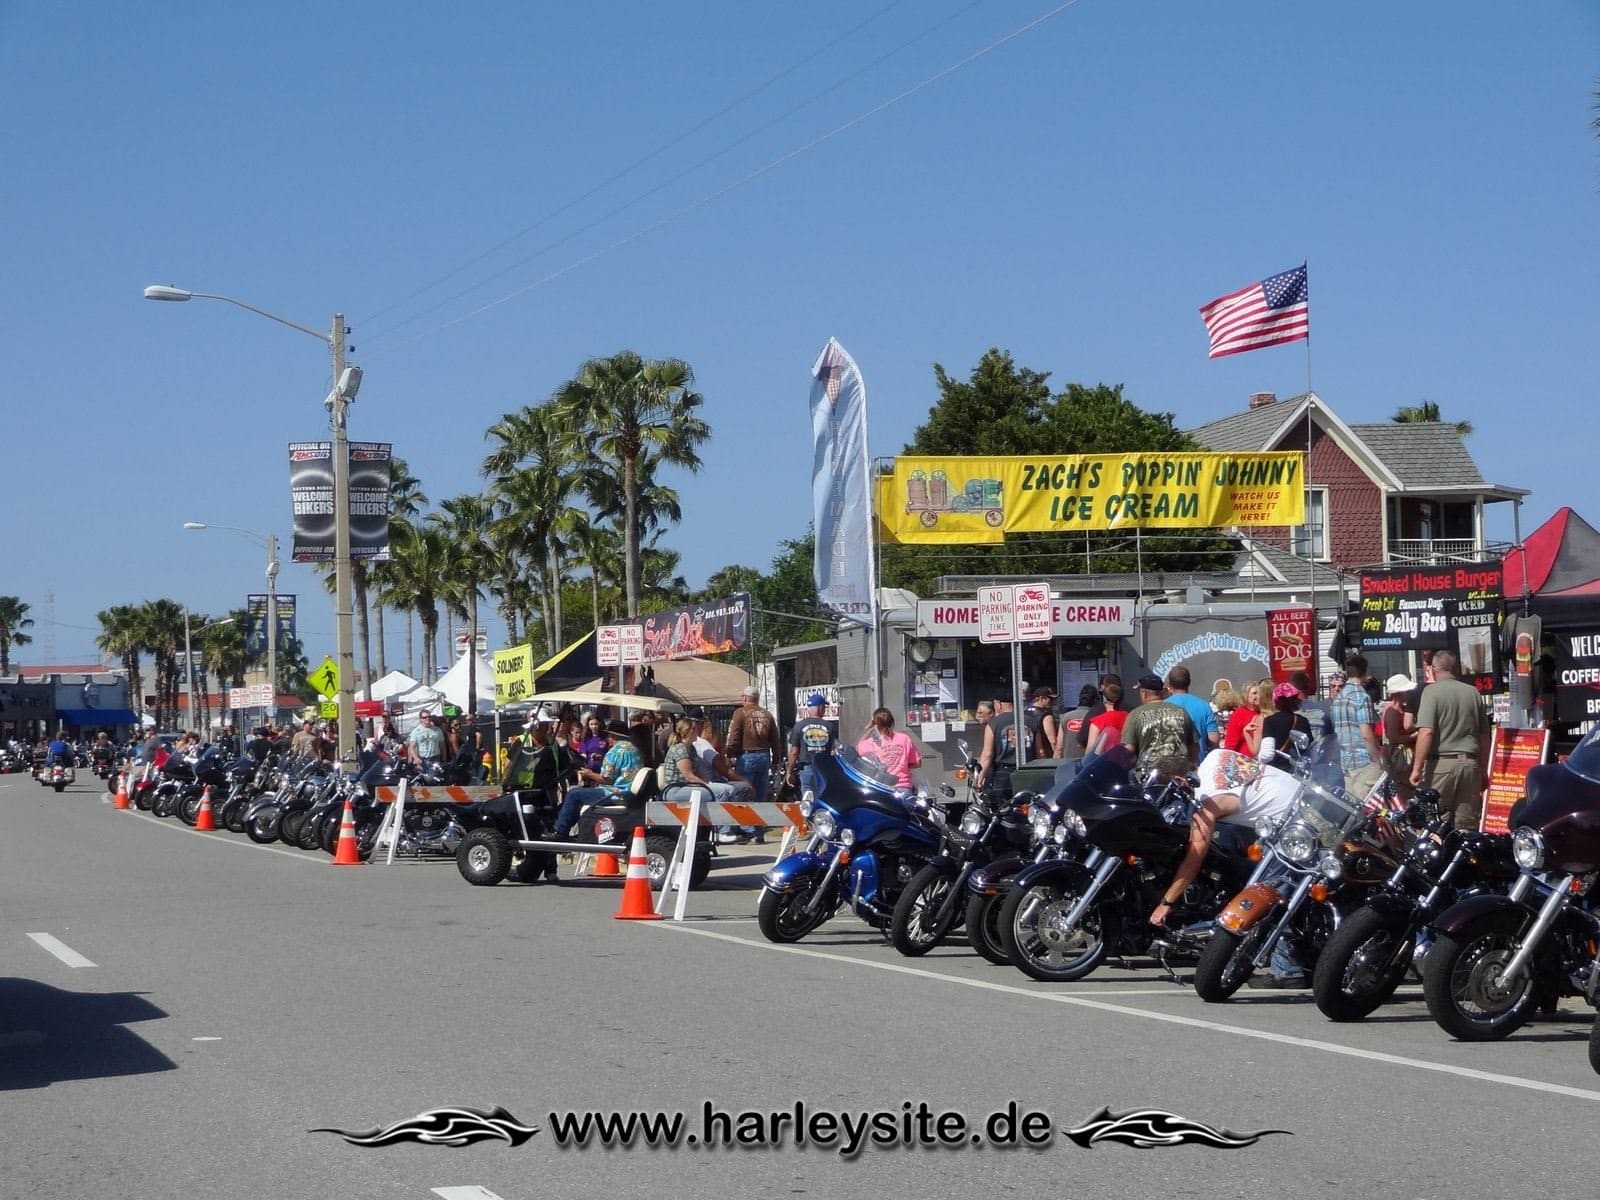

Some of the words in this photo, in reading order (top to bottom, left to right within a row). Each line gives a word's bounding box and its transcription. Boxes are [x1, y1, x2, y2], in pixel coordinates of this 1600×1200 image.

[290, 443, 318, 451] OFFICIAL
[319, 442, 331, 450] OIL
[350, 443, 375, 451] OFFICIAL
[1022, 461, 1103, 490] ZACH'S
[1215, 459, 1298, 486] JOHNNY
[292, 491, 334, 501] WELCOME
[350, 492, 388, 502] WELCOME
[1230, 492, 1264, 500] WATCH
[1266, 491, 1280, 499] US
[294, 502, 334, 515] BIKERS
[350, 503, 387, 515] BIKERS
[1050, 496, 1093, 521] ICE
[1105, 492, 1199, 520] CREAM
[1265, 502, 1276, 510] IT
[1239, 512, 1271, 521] HERE!
[1362, 574, 1409, 595] Smoked
[1413, 573, 1451, 592] House
[1455, 570, 1500, 591] Burger
[989, 591, 1003, 602] NO
[982, 603, 1011, 614] PARKING
[1016, 603, 1048, 612] PARKING
[1362, 598, 1382, 611] Fresh
[1383, 597, 1395, 610] Cut
[1399, 600, 1427, 609] Famous
[1458, 600, 1485, 611] ICED
[934, 607, 979, 624] HOME
[991, 615, 1004, 623] ANY
[1024, 613, 1041, 621] ONLY
[1066, 605, 1121, 622] CREAM
[1272, 612, 1289, 621] ALL
[1290, 612, 1309, 621] BEEF
[1362, 617, 1381, 632] Fries
[1384, 612, 1418, 639] Belly
[1420, 612, 1447, 632] Bus
[1451, 613, 1495, 627] COFFEE
[990, 623, 1006, 631] TIME
[1272, 621, 1311, 639] HOT
[1571, 635, 1600, 657] WELC
[1273, 644, 1312, 661] DOG
[1562, 668, 1600, 685] COFFE
[508, 679, 526, 697] JESUS
[323, 704, 336, 712] 20
